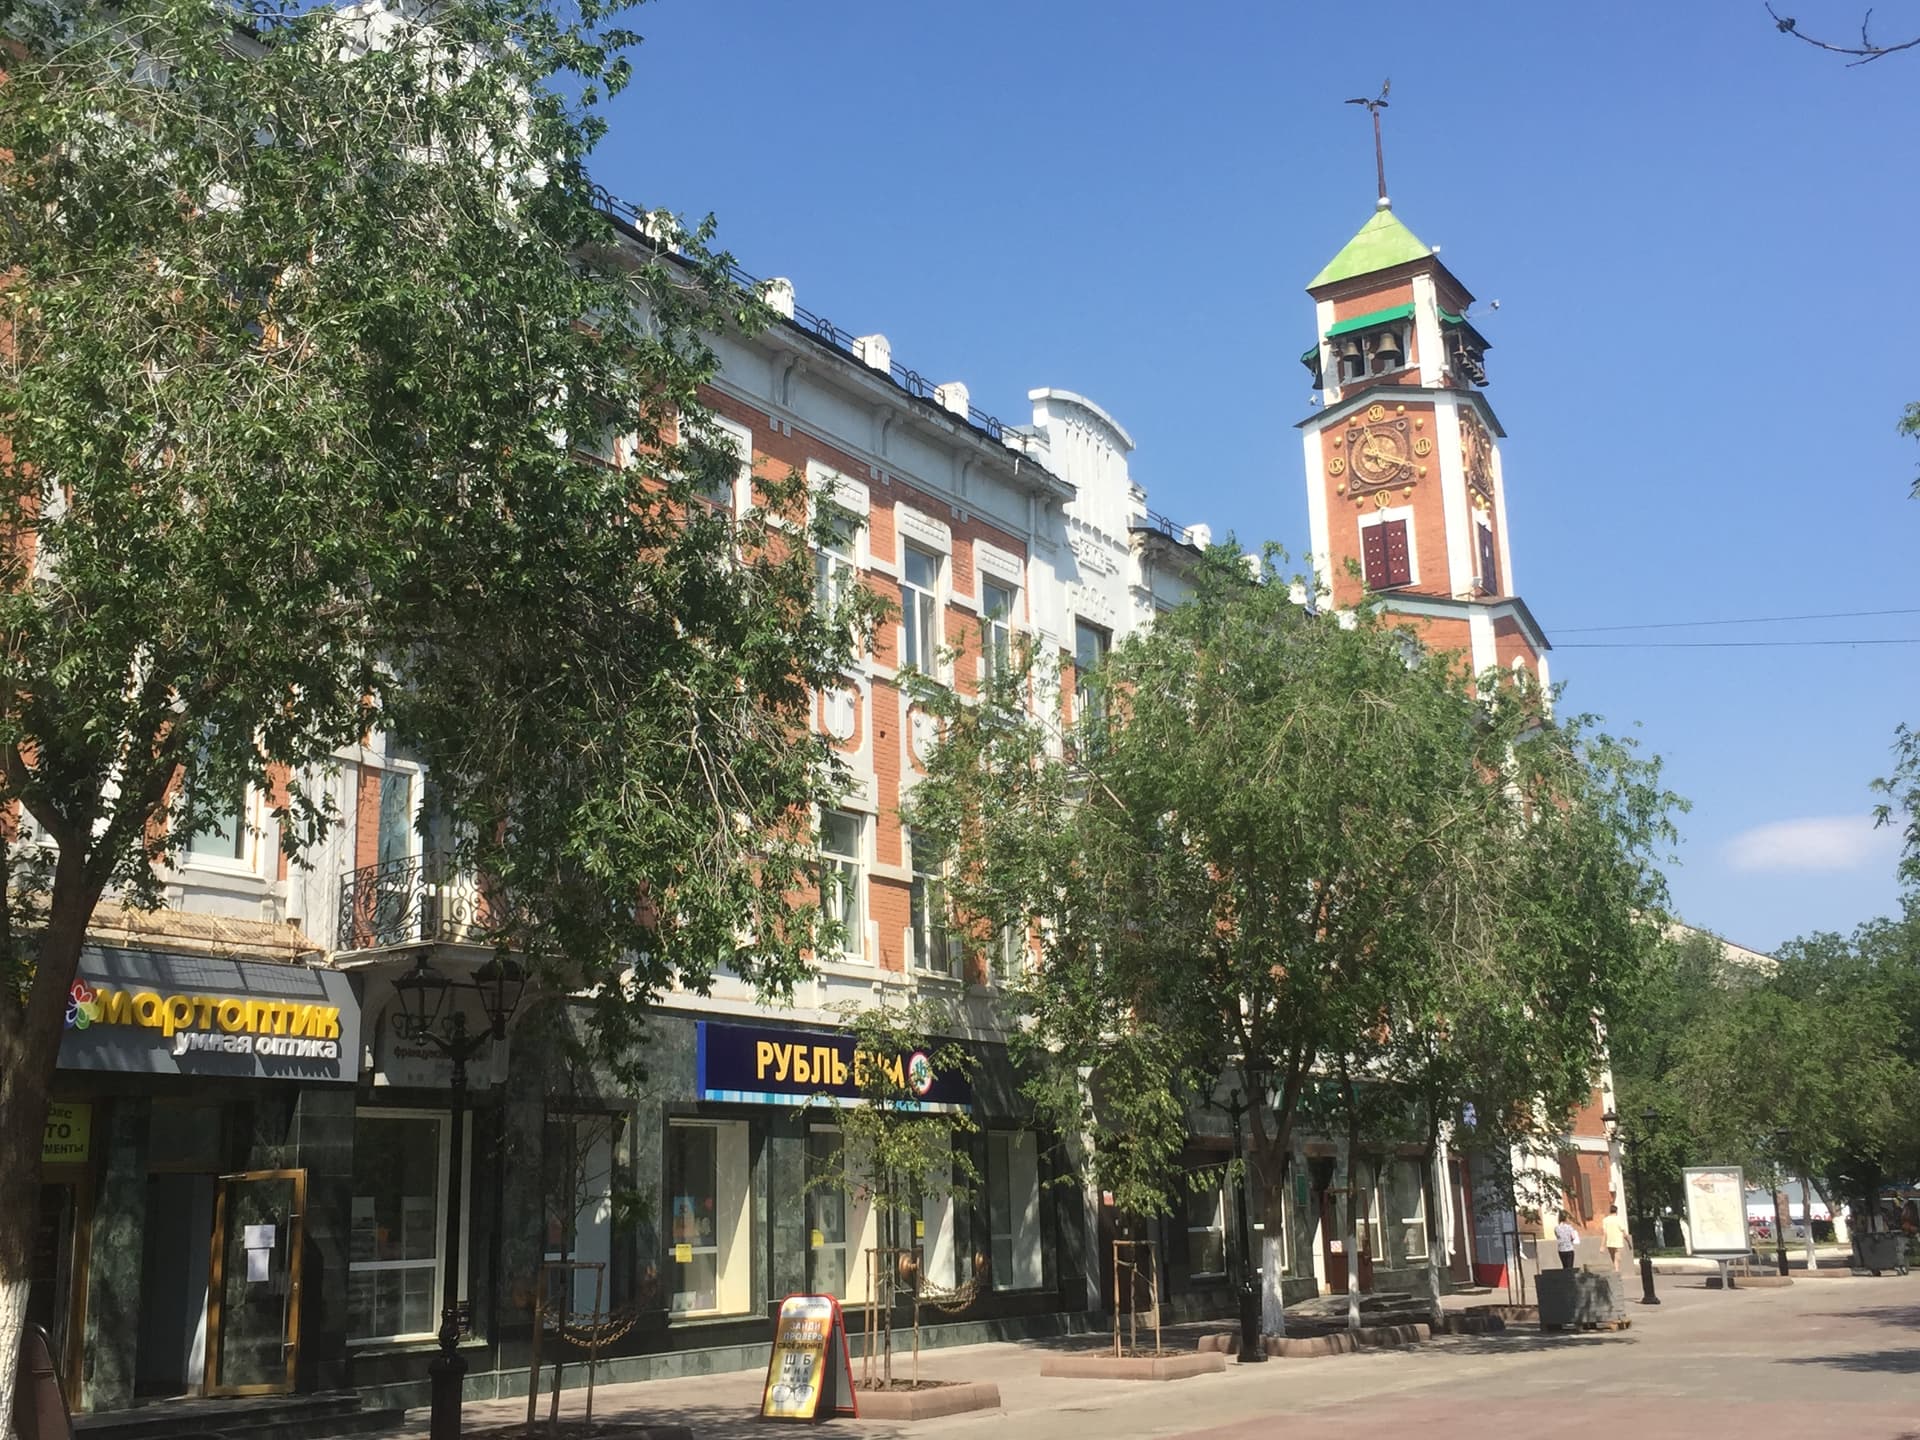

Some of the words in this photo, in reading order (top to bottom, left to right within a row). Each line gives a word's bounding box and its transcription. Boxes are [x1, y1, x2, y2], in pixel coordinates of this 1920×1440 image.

[173, 1031, 252, 1056] умная
[256, 1035, 337, 1059] оптика
[756, 1041, 849, 1086] РУБЛЬ
[803, 1354, 811, 1365] Б
